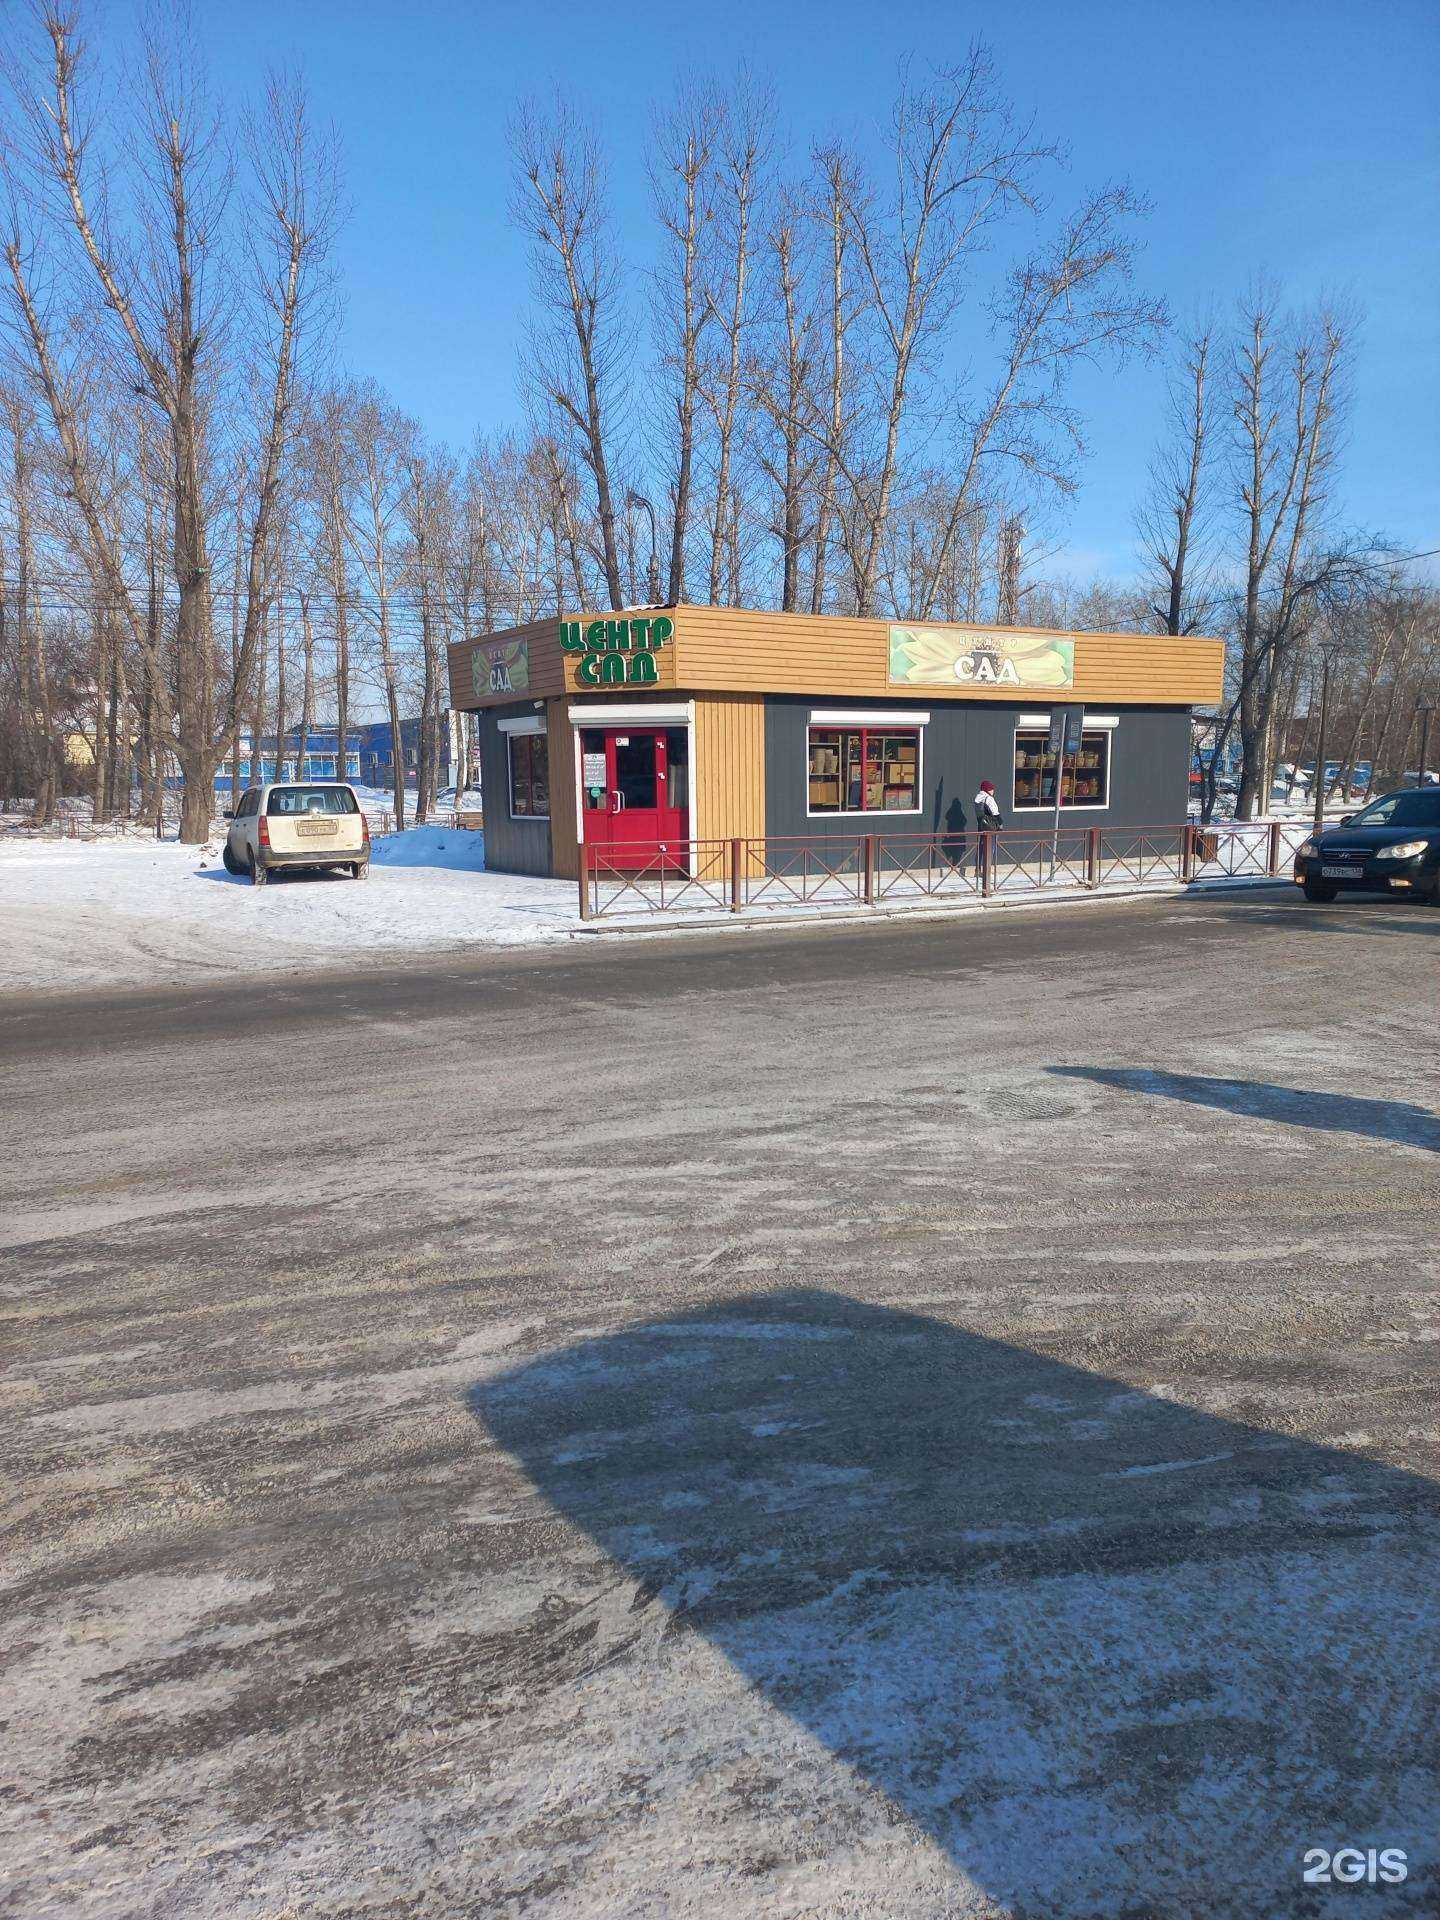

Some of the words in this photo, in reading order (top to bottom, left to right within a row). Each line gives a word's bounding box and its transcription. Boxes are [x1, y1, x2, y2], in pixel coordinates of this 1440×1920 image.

[559, 616, 674, 650] ЦЕНТР
[580, 653, 660, 683] САД
[954, 655, 1020, 684] САД
